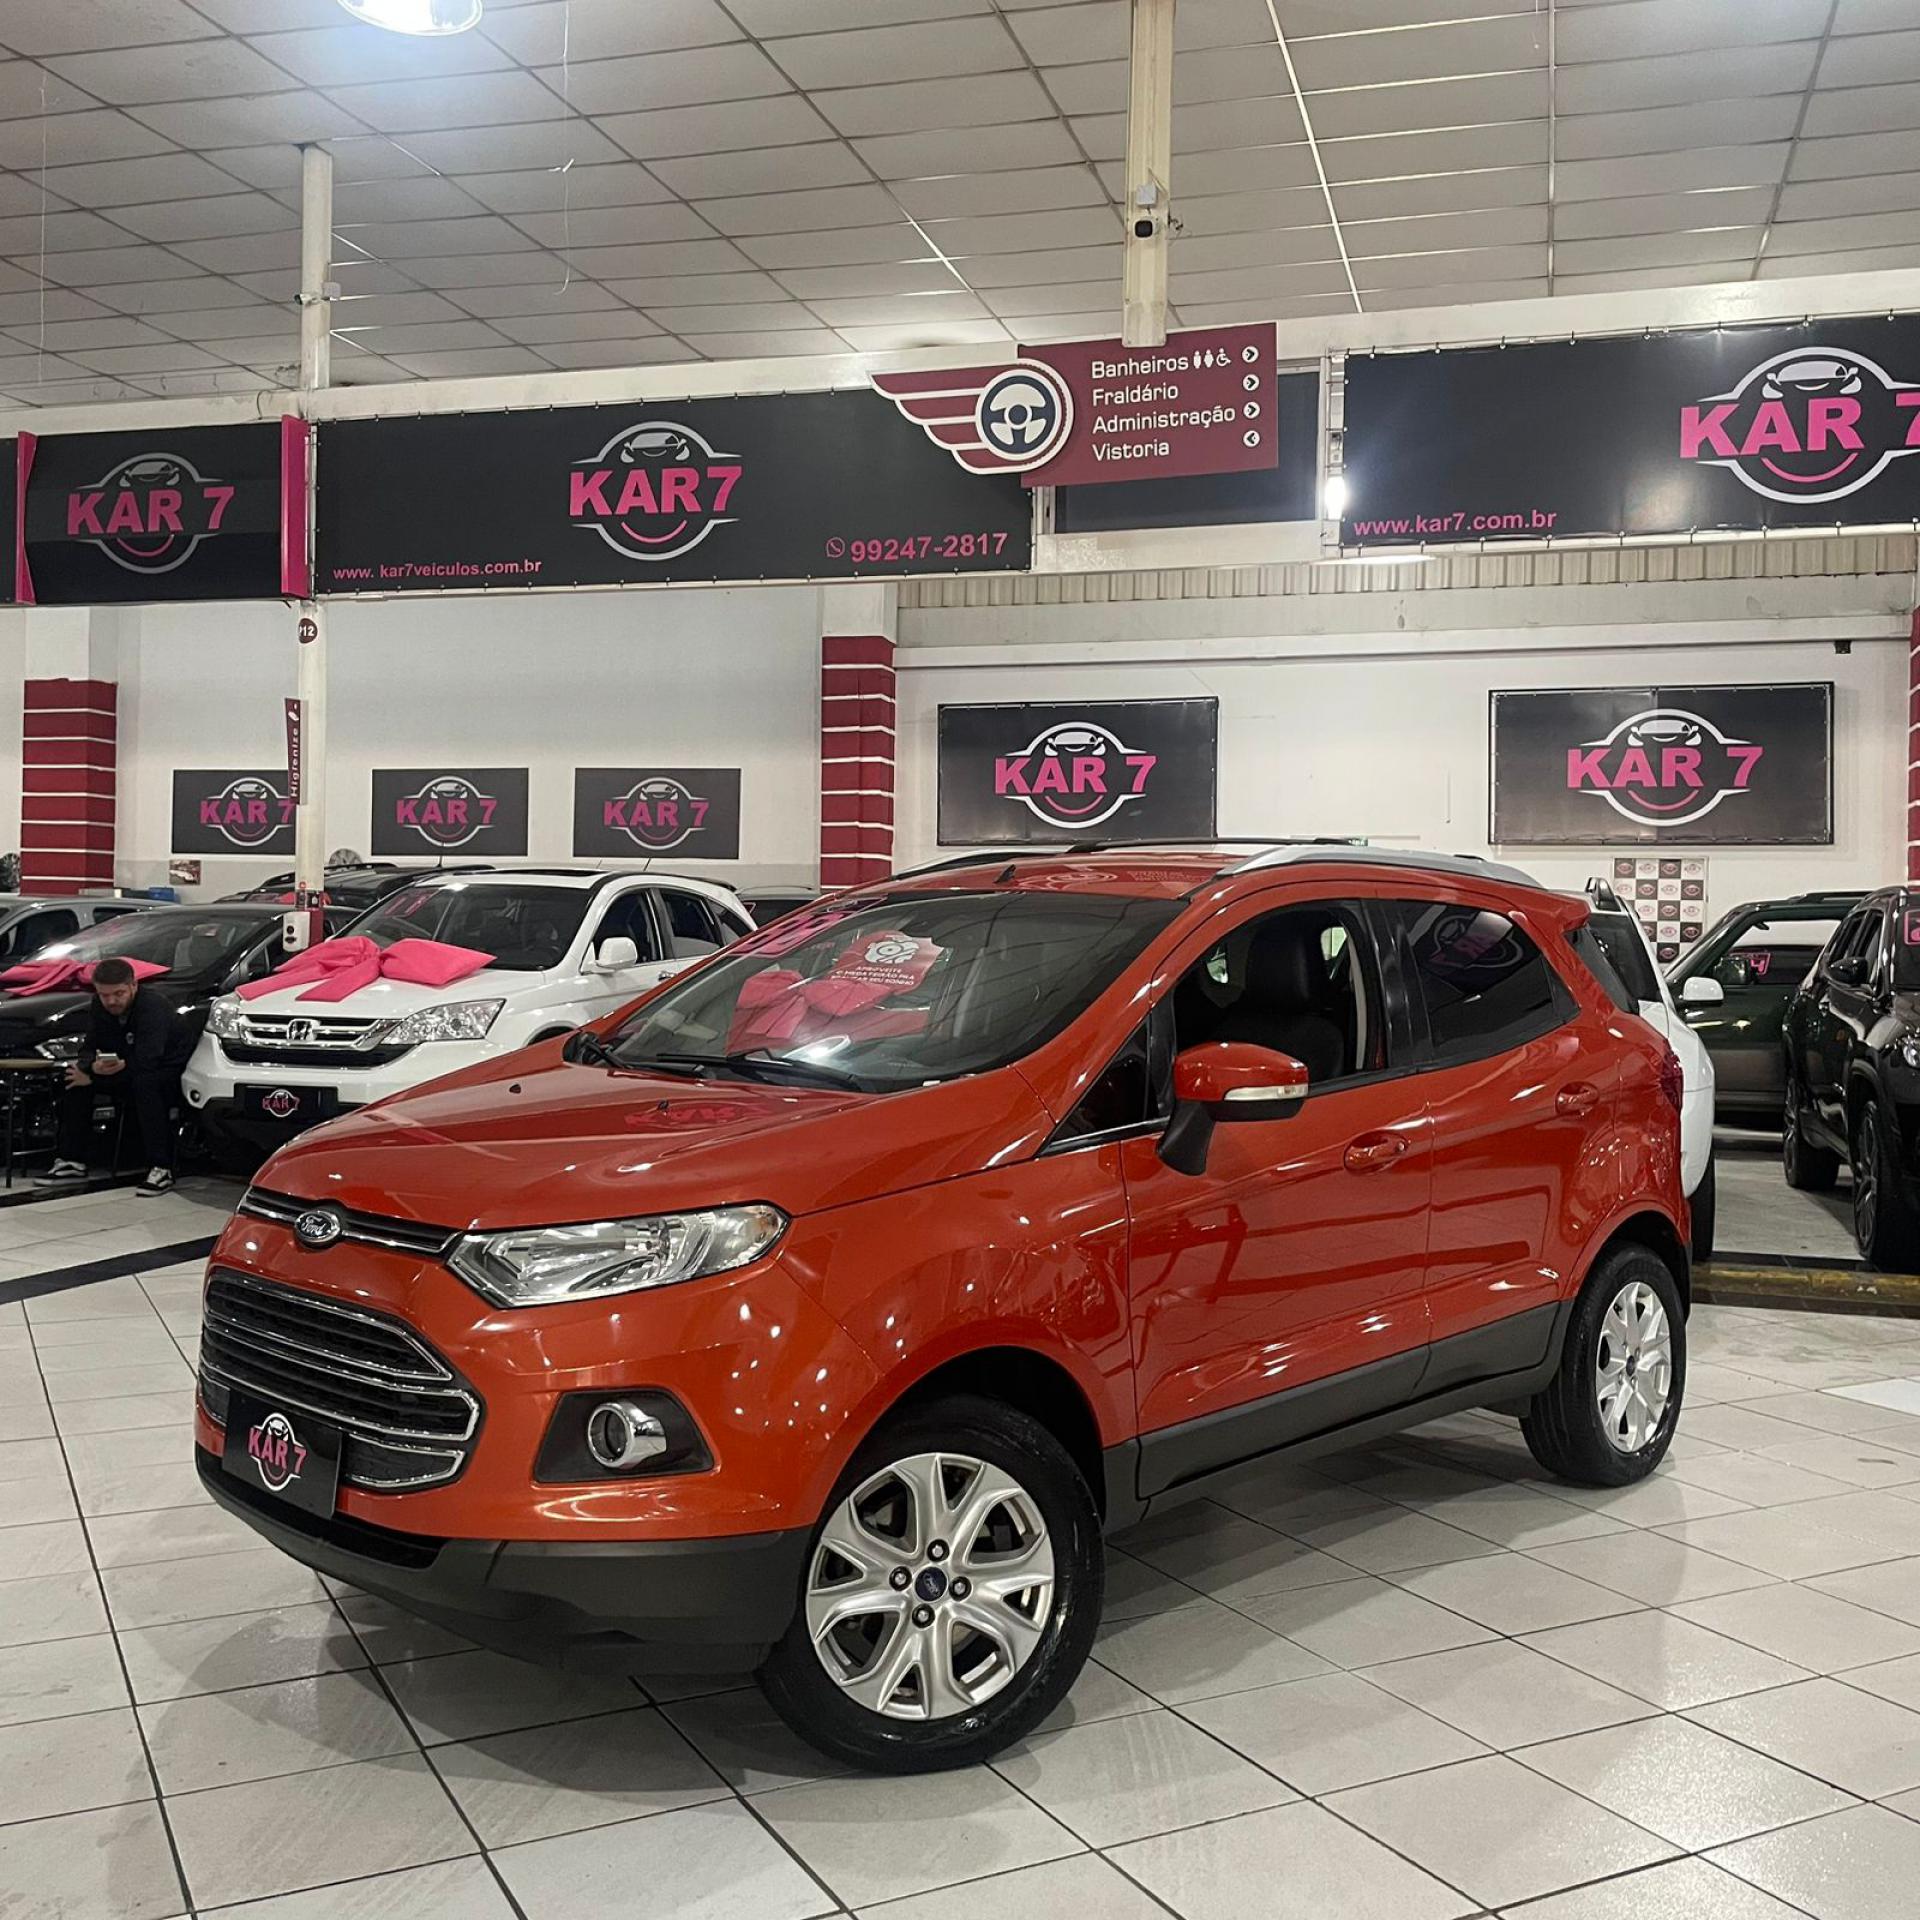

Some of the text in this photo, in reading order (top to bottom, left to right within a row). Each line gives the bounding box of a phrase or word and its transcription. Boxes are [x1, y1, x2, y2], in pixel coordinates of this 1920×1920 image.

[1091, 355, 1189, 379] Banheiros
[1092, 382, 1179, 407] Fraldário
[1092, 405, 1236, 435] Administração
[1679, 396, 1866, 460] KAR
[1092, 438, 1170, 462] Vistoria
[67, 485, 236, 536] KAR 7
[1353, 510, 1557, 536] www.kar7.com.br
[850, 532, 1008, 564] 99247-2817
[379, 558, 543, 578] kar7veiculos.com.br
[994, 754, 1158, 797] KAR 7
[1567, 746, 1764, 790] KAR 7
[200, 799, 295, 825] KAR 7
[395, 799, 498, 826] KAR 7
[603, 800, 710, 827] KAR 7
[247, 1427, 308, 1474] KAR 7
